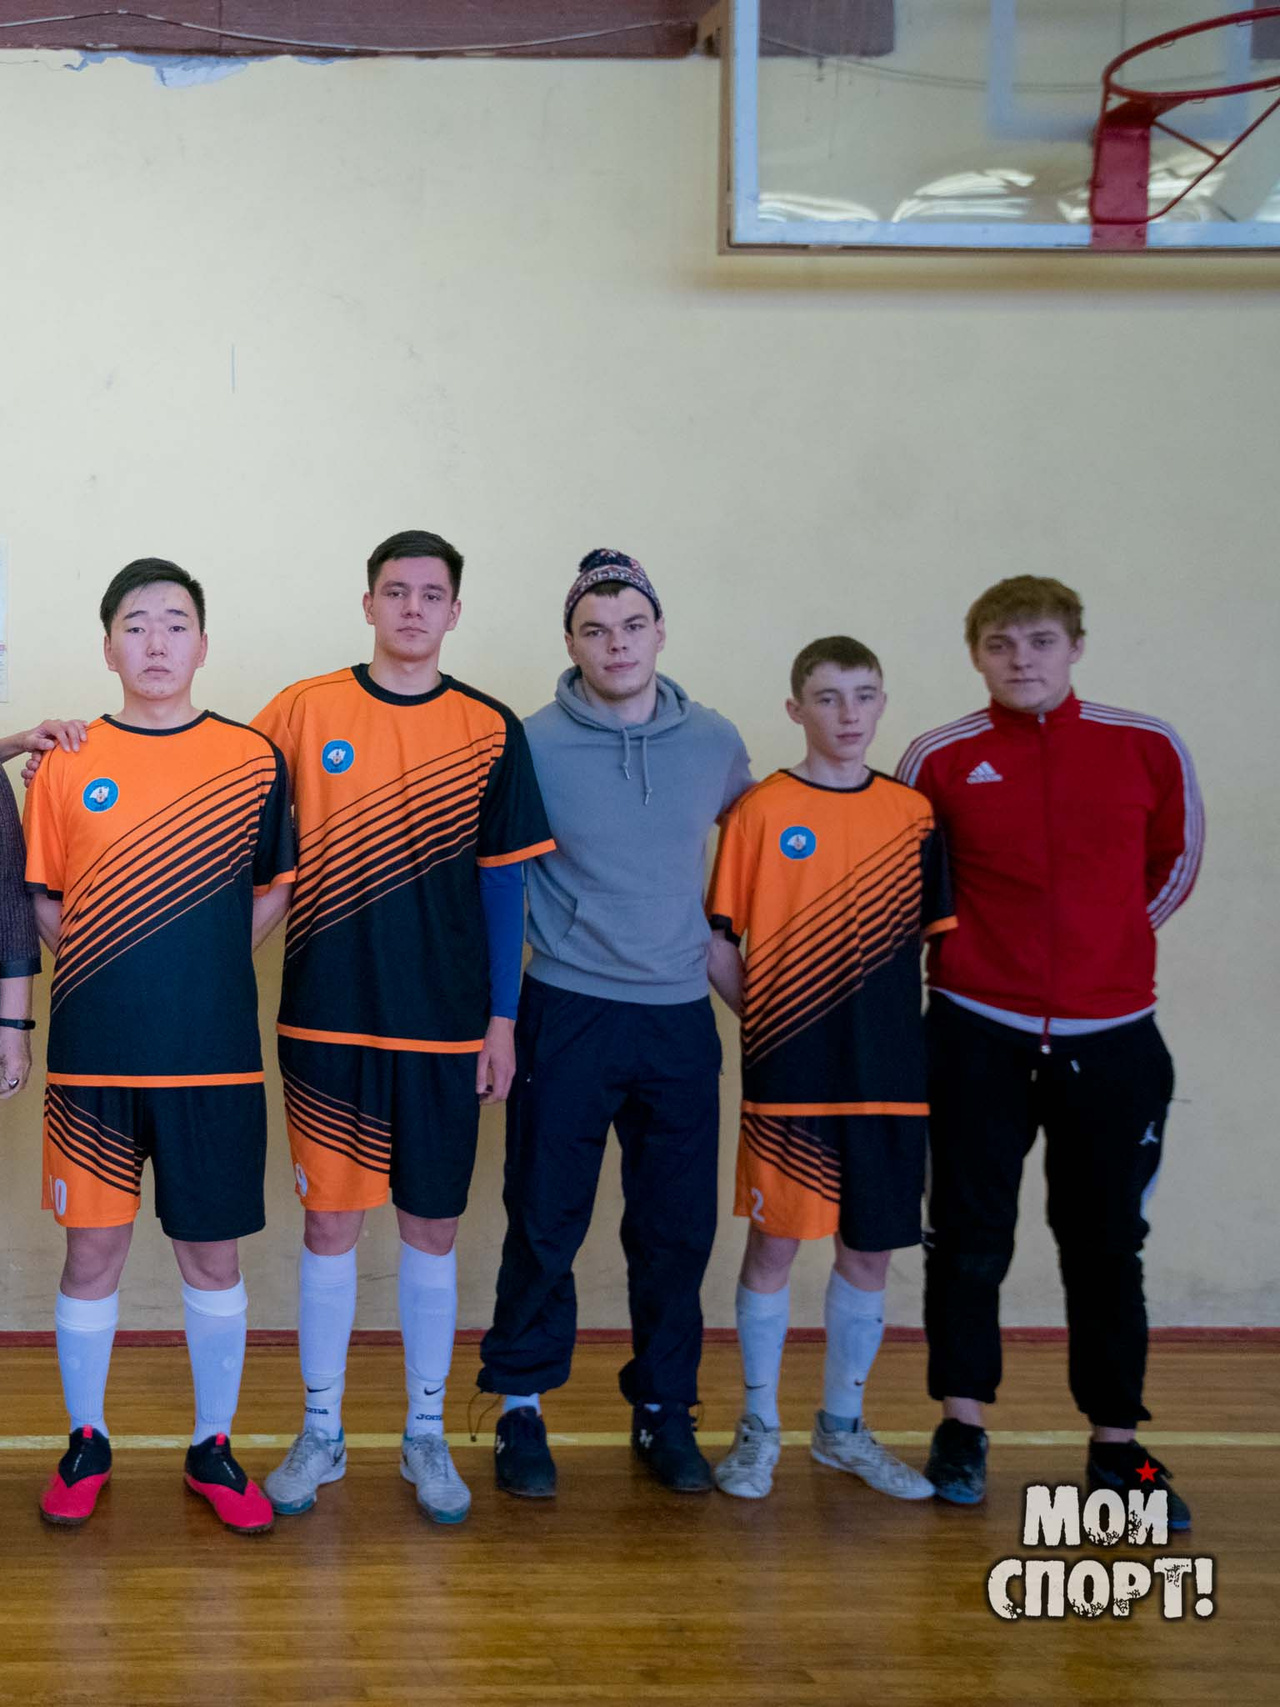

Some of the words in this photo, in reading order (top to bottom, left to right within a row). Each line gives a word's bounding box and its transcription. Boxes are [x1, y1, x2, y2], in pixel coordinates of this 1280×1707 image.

[751, 1188, 765, 1222] 2
[305, 1406, 329, 1415] oma
[415, 1413, 443, 1421] Jom
